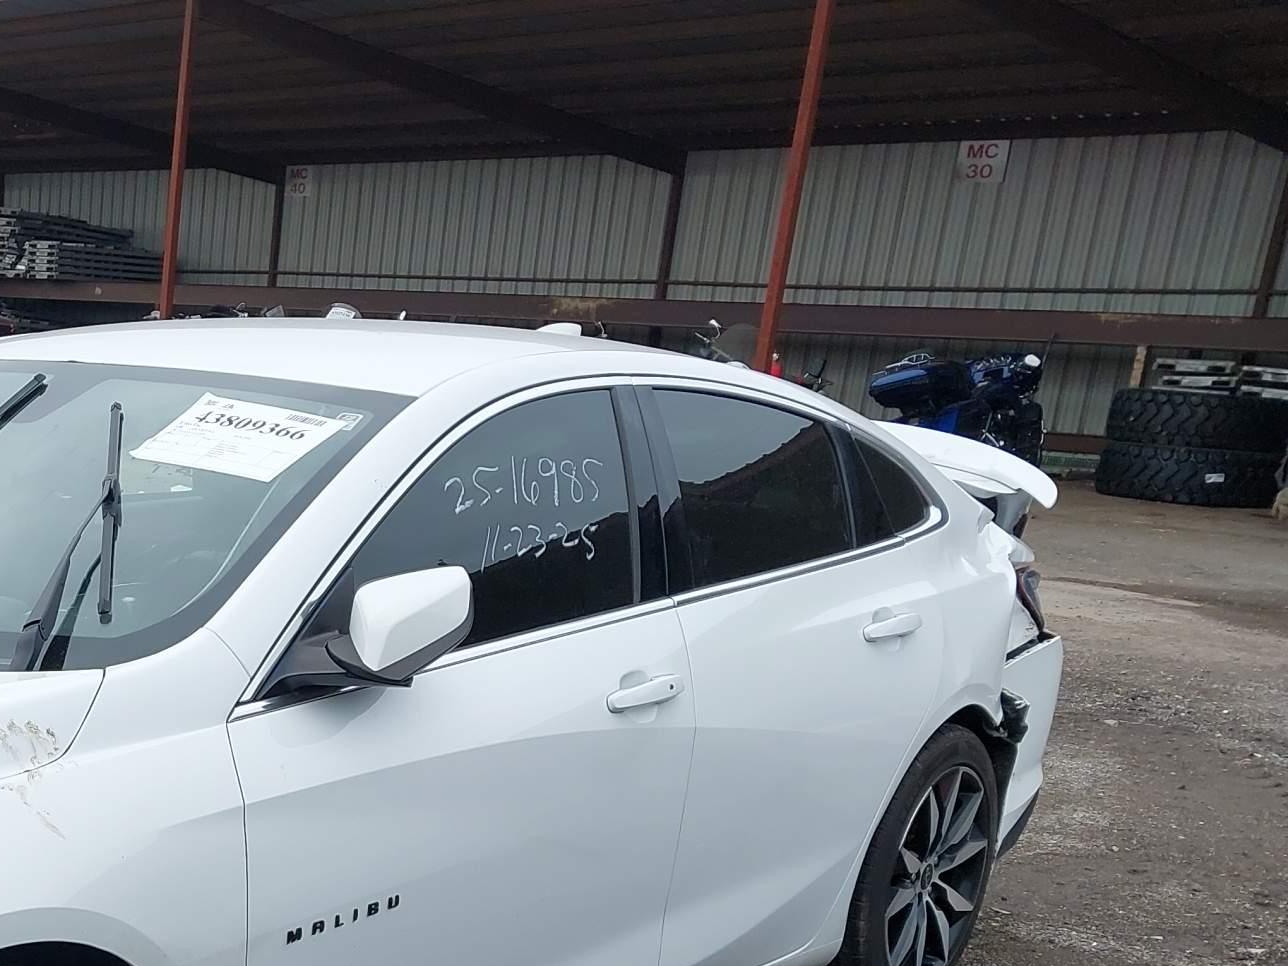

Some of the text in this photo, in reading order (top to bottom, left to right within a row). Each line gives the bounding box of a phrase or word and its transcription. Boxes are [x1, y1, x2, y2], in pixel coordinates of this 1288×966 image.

[966, 143, 1000, 159] MC
[966, 163, 994, 179] 30
[195, 411, 313, 441] 43809366
[444, 455, 603, 514] 25-16985
[480, 522, 600, 573] 11-23-25
[286, 894, 400, 945] MALIBU
